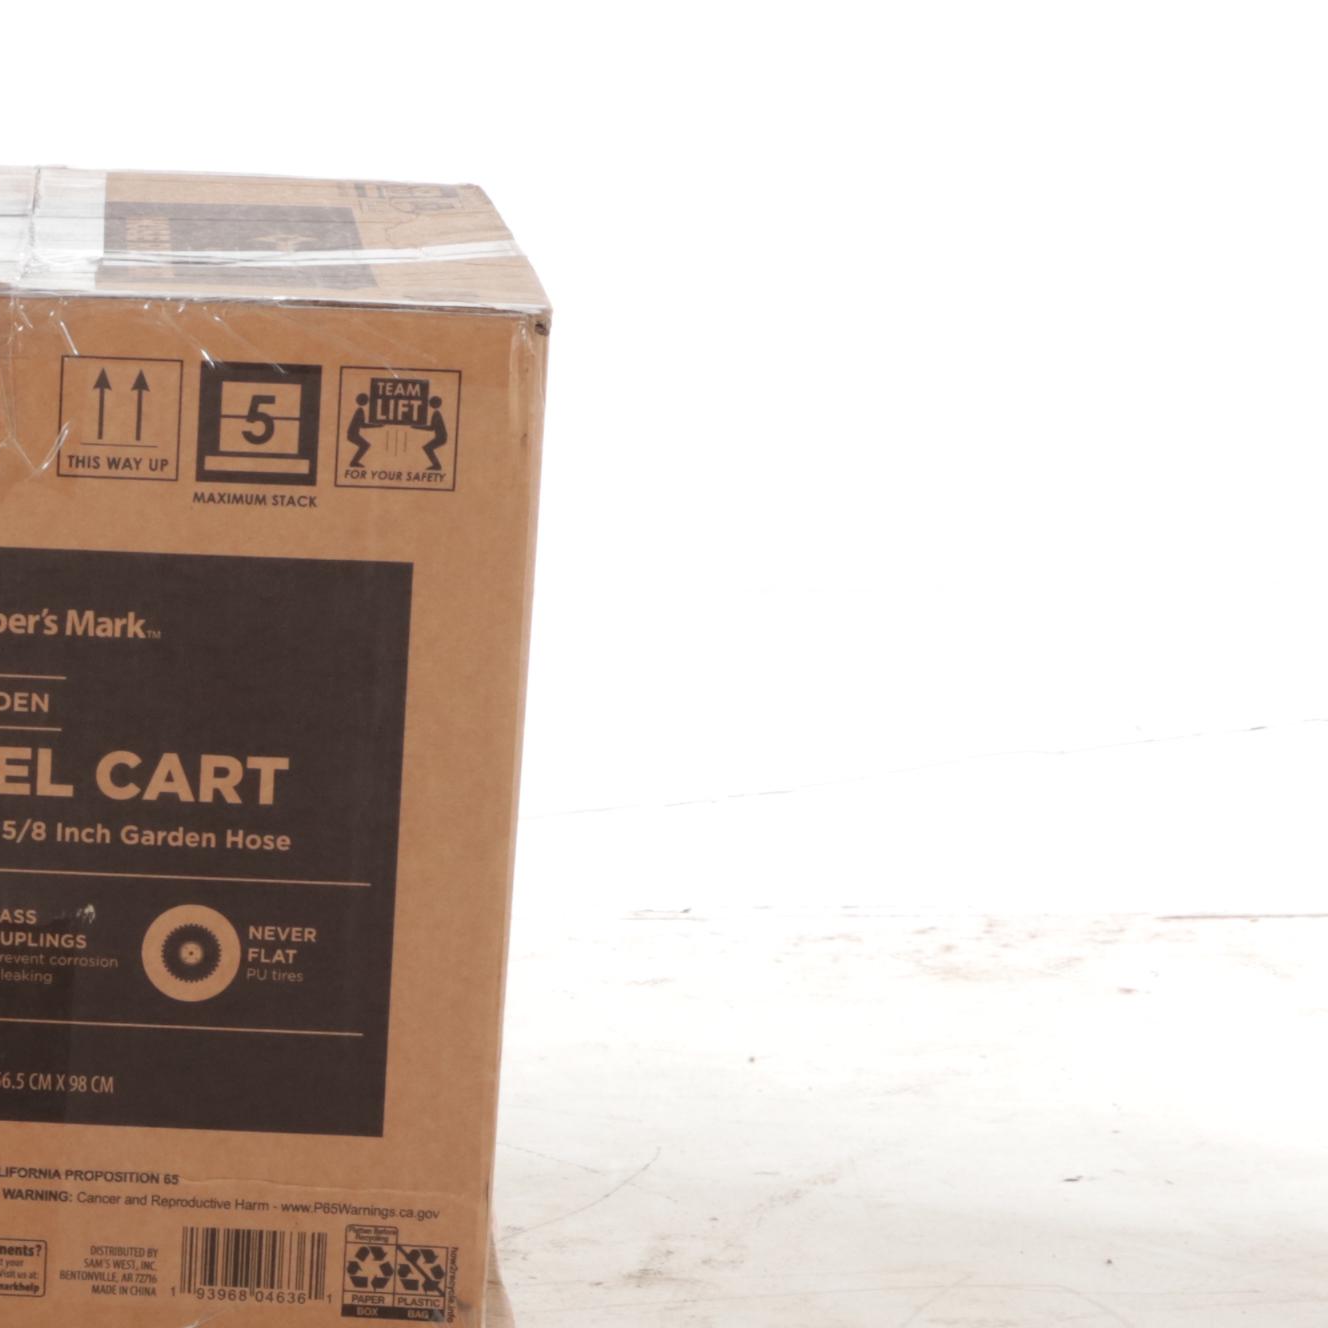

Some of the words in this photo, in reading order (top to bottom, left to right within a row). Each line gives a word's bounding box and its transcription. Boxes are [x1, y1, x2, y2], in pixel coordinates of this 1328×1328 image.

[377, 382, 421, 397] TEAM
[375, 398, 422, 422] LIFT
[242, 395, 275, 444] 5
[67, 455, 100, 470] THIS
[107, 456, 142, 471] WAY
[148, 457, 169, 472] UP
[344, 469, 369, 481] FOR
[372, 470, 403, 482] YOUR
[407, 471, 447, 483] SAFETY
[193, 490, 267, 506] MAXIMUM
[271, 492, 318, 508] STACK
[96, 751, 289, 805] CART
[2, 818, 48, 843] 5/8
[56, 819, 112, 845] Inch
[120, 822, 216, 849] Garden
[226, 828, 292, 853] Hose
[248, 925, 317, 943] NEVER
[50, 954, 119, 969] corrosion
[248, 946, 297, 964] FLAT
[0, 968, 53, 985] leaking
[247, 967, 267, 981] PU
[271, 969, 304, 982] tires
[29, 1075, 52, 1092] CM
[55, 1076, 66, 1092] X
[69, 1077, 89, 1094] 98
[91, 1077, 114, 1095] CM
[65, 1169, 161, 1185] PROPOSITION
[163, 1173, 179, 1185] 65
[3, 1188, 73, 1203] WARNING:
[77, 1192, 121, 1206] Cancer
[125, 1194, 148, 1207] and
[152, 1194, 231, 1212] Reproductive
[235, 1198, 269, 1211] Harm
[281, 1201, 440, 1221] www.P65Warnings.ca.gov
[90, 1245, 144, 1257] DISTRIBUTED
[147, 1248, 158, 1258] BY
[121, 1272, 133, 1282] AR
[92, 1284, 116, 1295] MADE
[119, 1286, 128, 1295] IN
[129, 1286, 157, 1296] CHINA
[196, 1288, 248, 1302] 93968
[255, 1291, 307, 1304] 04636
[352, 1295, 385, 1304] PAPER
[398, 1297, 440, 1307] PLASTIC
[357, 1307, 378, 1316] BOX
[408, 1310, 429, 1319] BAG
